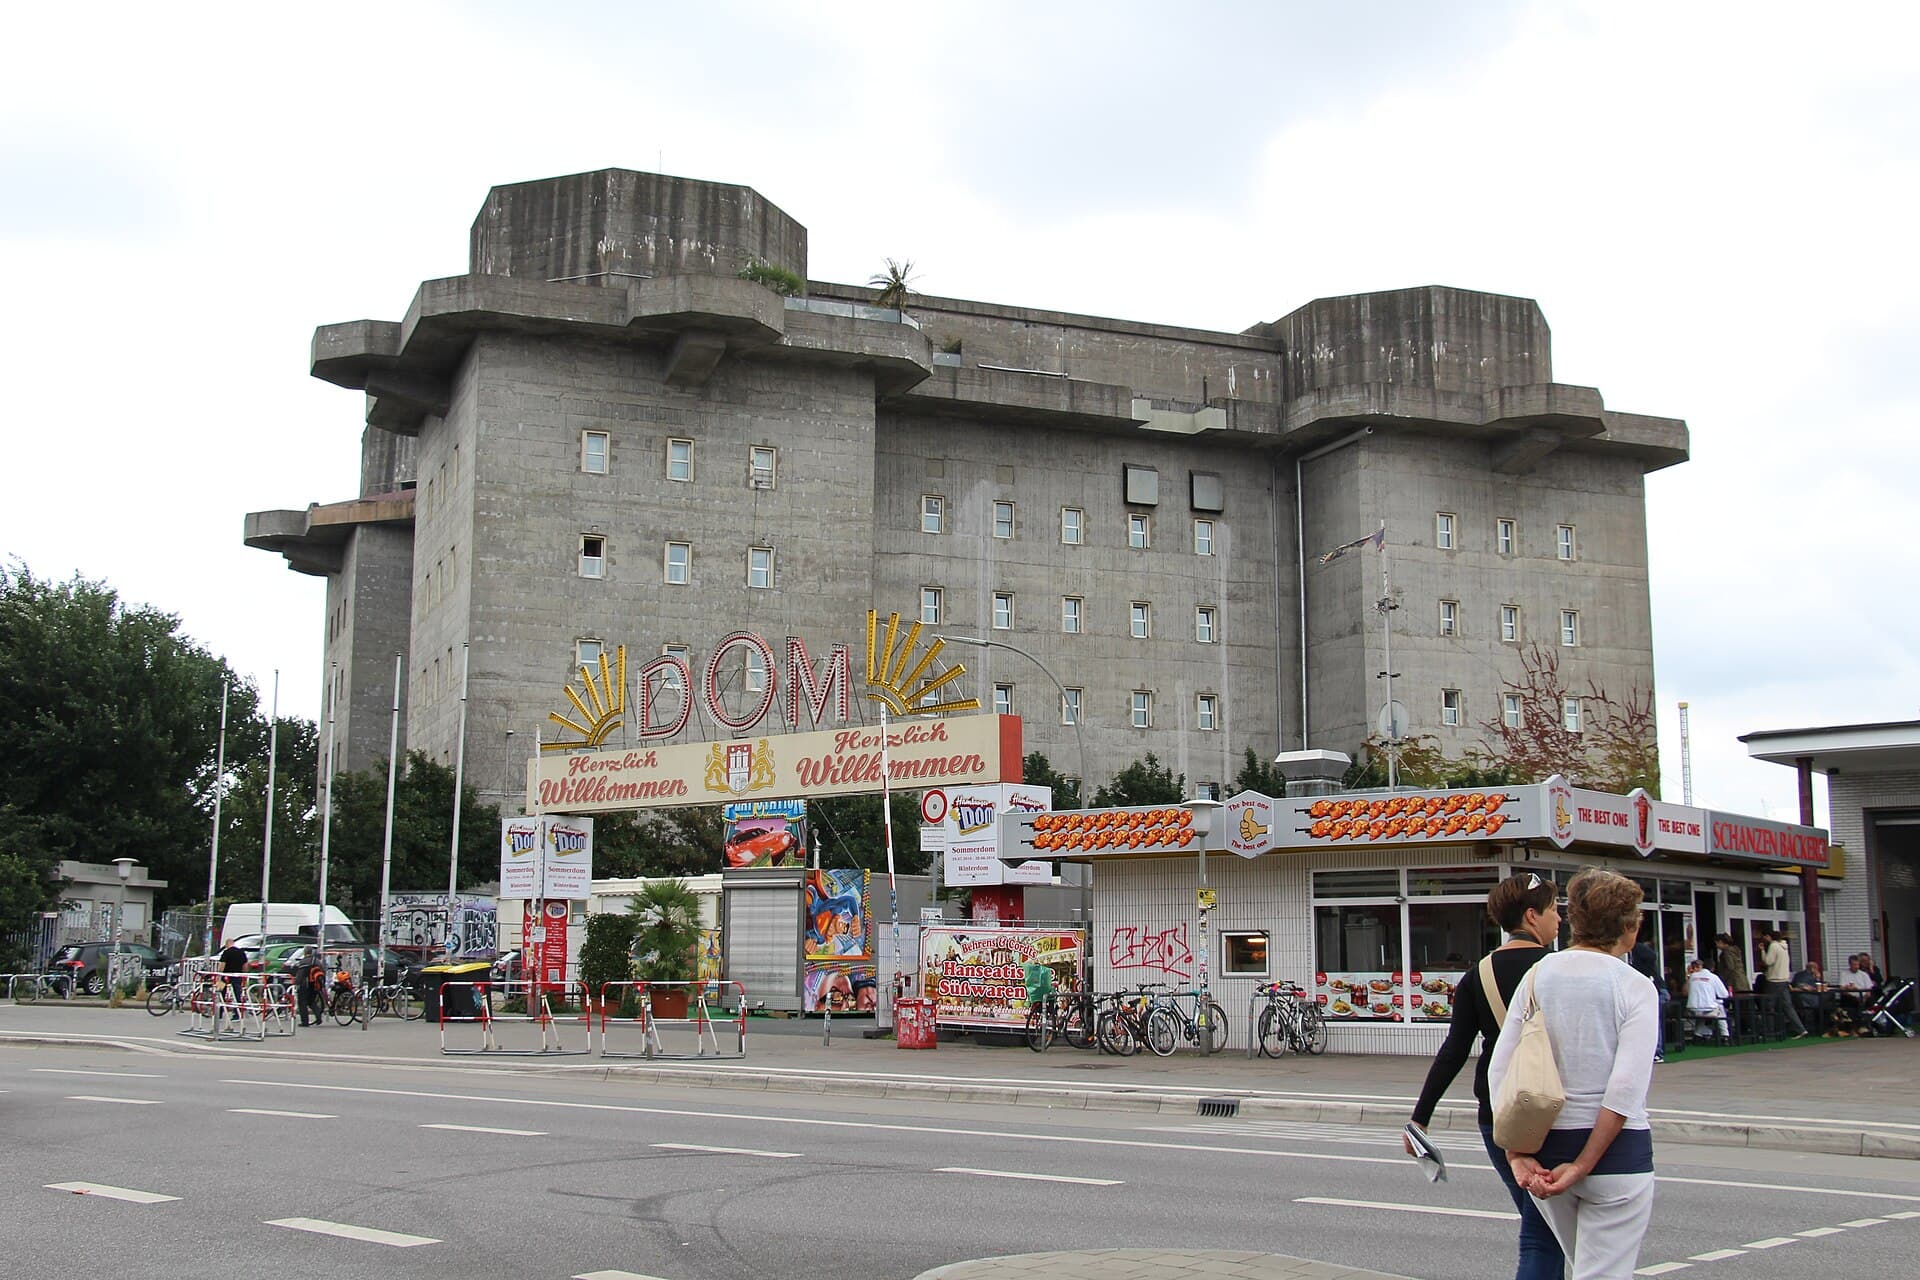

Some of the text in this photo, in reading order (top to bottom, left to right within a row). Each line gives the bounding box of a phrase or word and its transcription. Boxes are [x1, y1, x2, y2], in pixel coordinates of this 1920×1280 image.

[637, 631, 850, 740] DOM
[569, 750, 658, 776] Herzlich
[539, 775, 688, 807] Willkommen
[1228, 803, 1240, 811] The
[1578, 807, 1629, 828] THE BEST ONE
[1658, 818, 1701, 836] THE BEST ONE
[1232, 840, 1241, 849] The
[1713, 820, 1778, 856] SCHANZEN
[962, 939, 996, 953] Behrens
[998, 936, 1007, 947] &
[1008, 939, 1037, 958] Cordts
[939, 980, 1027, 999] Süßwaren
